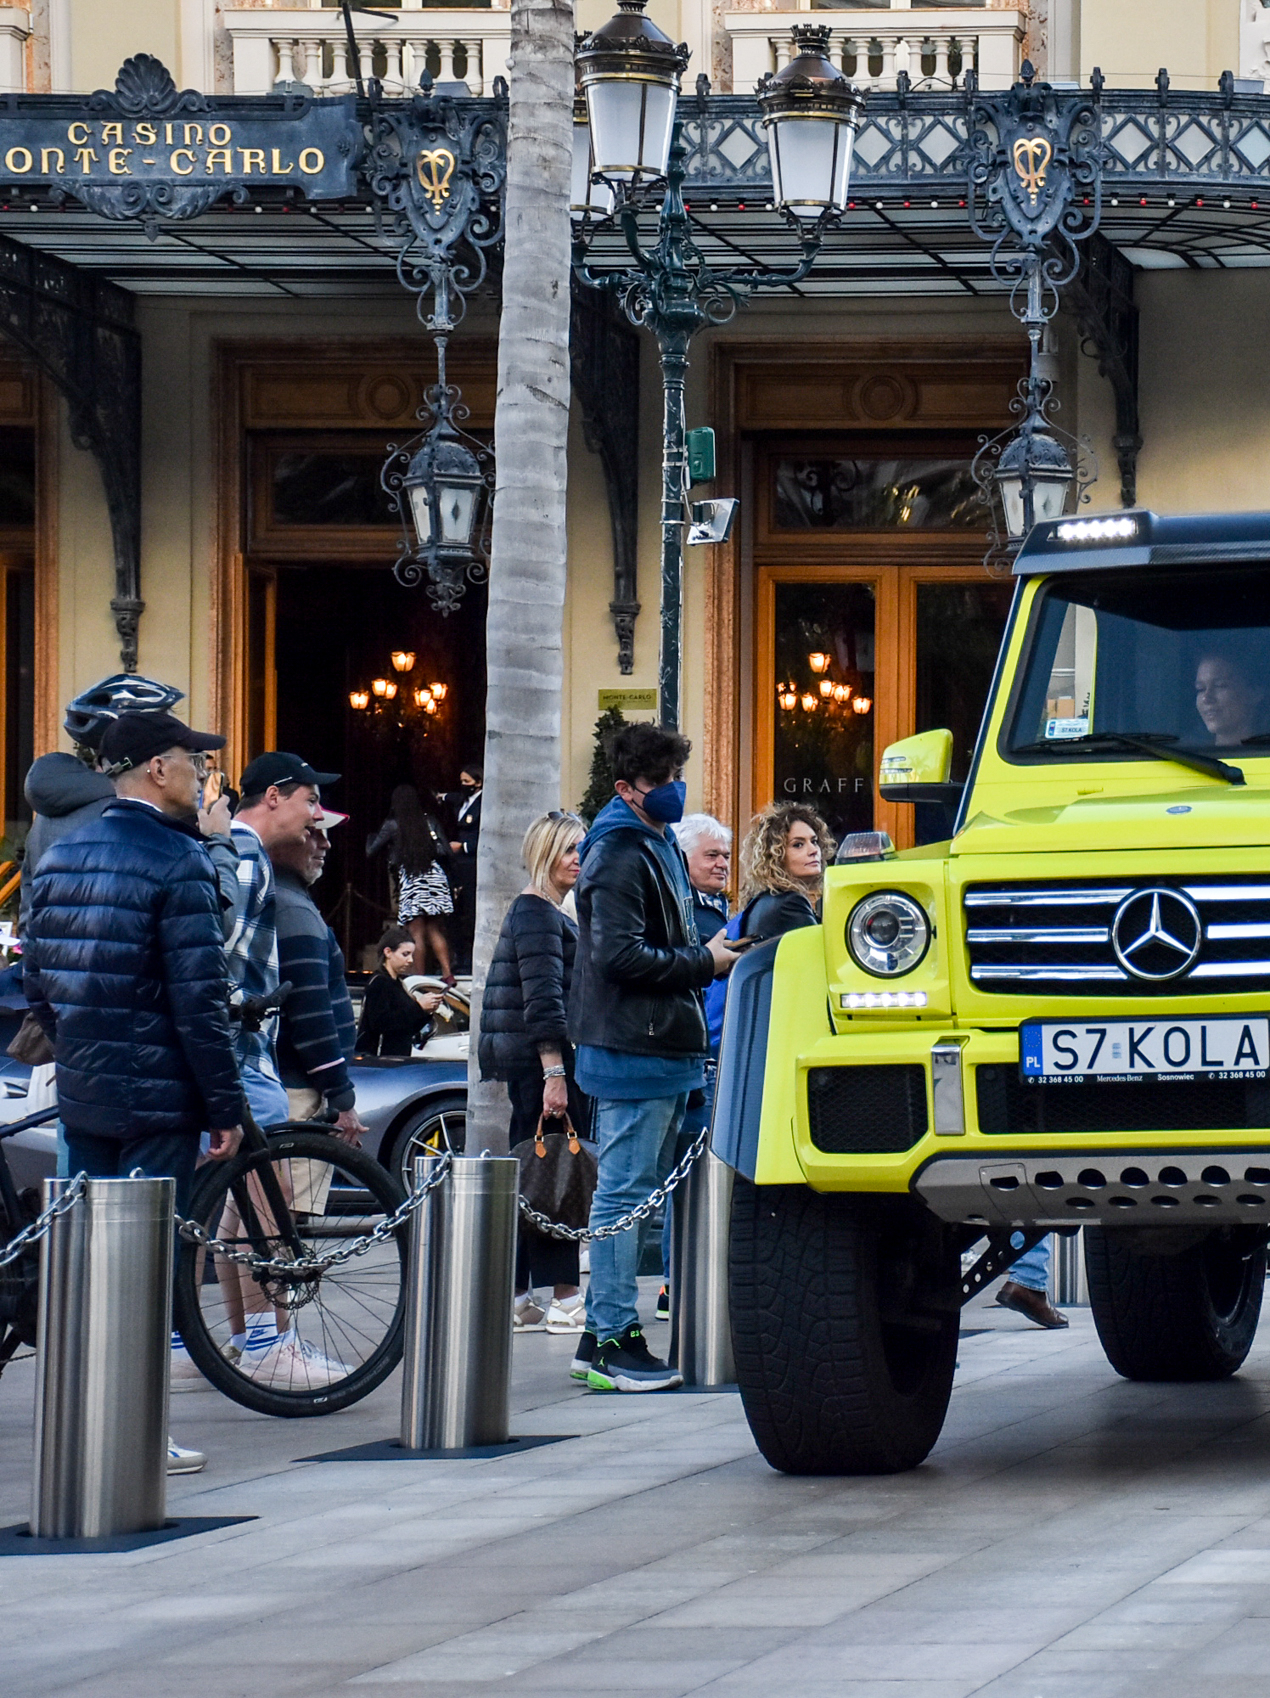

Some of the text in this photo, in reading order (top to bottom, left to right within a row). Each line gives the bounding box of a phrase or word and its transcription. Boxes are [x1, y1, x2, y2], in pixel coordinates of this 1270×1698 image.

[67, 121, 232, 146] CASINO
[5, 146, 325, 175] ONTE-CARLO
[783, 777, 864, 793] GRAFF
[1052, 1025, 1261, 1071] S7 KOLA
[1026, 1056, 1041, 1068] PL
[1074, 1075, 1084, 1083] 00
[1157, 1073, 1195, 1081] Sosnowiec
